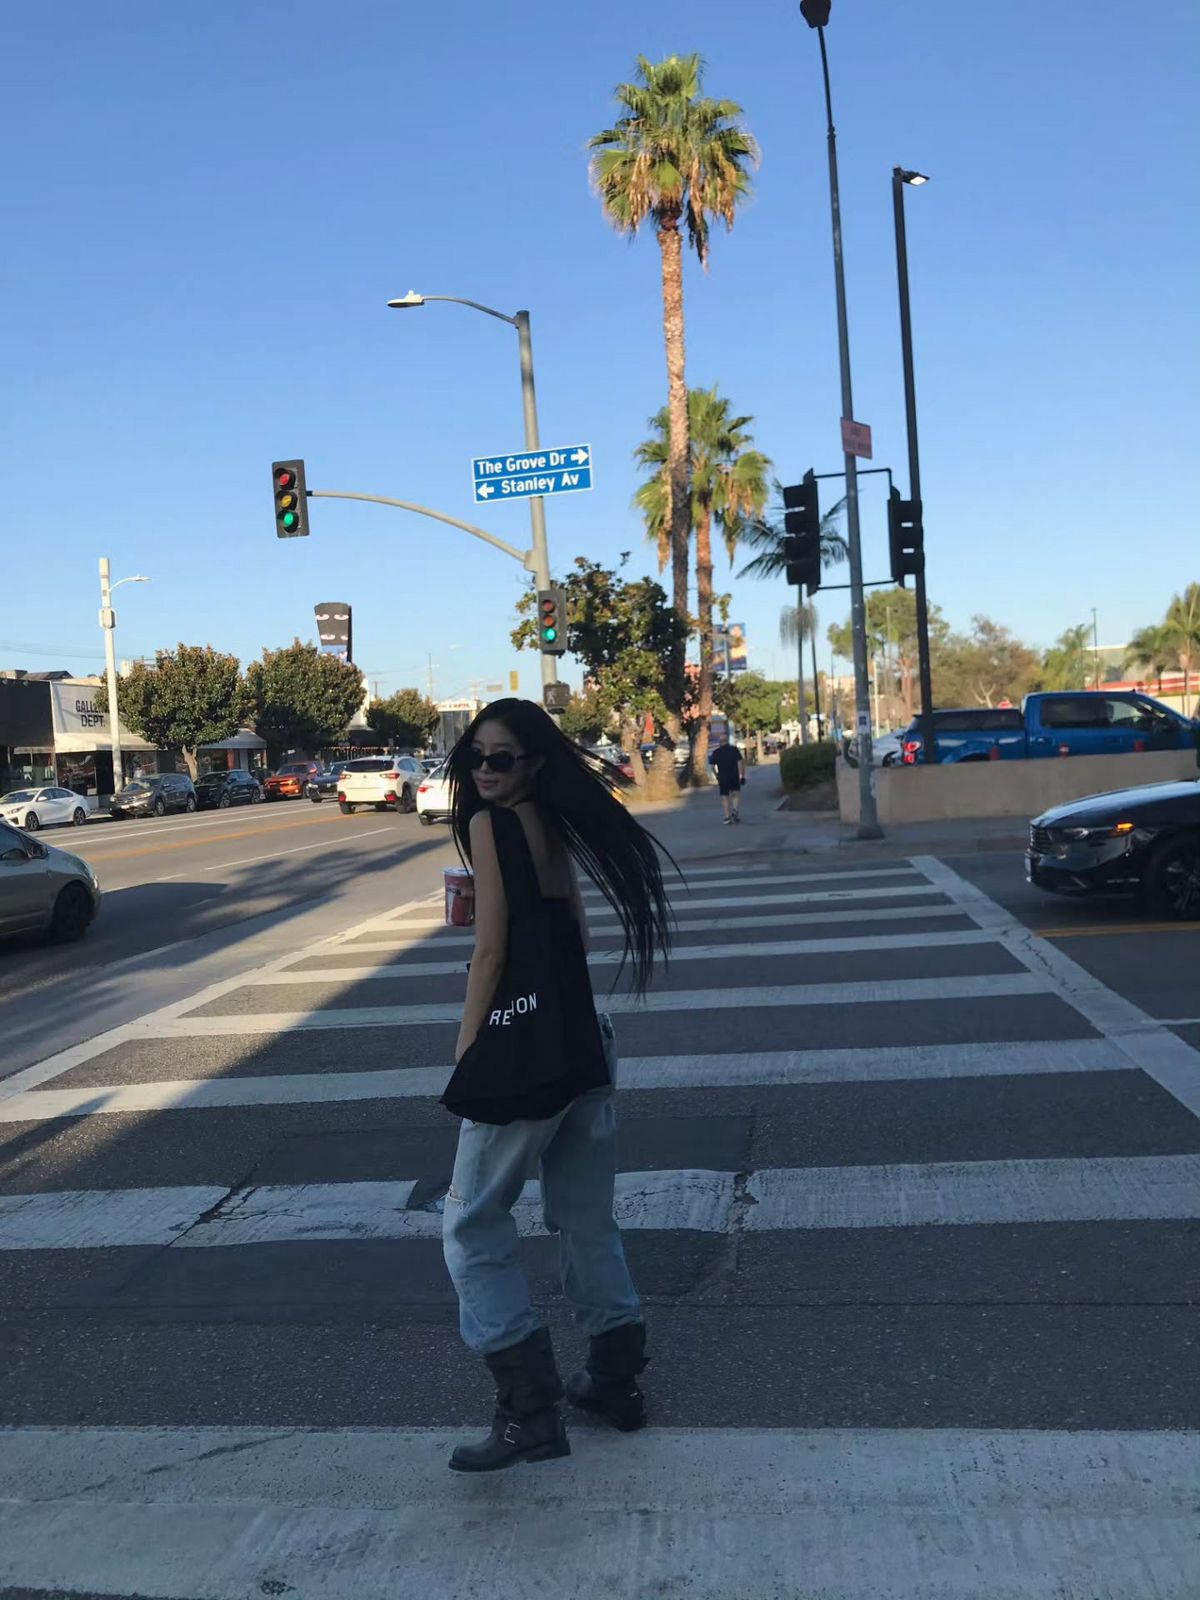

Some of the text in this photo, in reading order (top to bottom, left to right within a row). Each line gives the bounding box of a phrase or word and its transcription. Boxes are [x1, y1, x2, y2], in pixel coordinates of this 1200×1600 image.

[477, 452, 567, 475] The Grove Dr
[501, 472, 579, 494] Stanley Av
